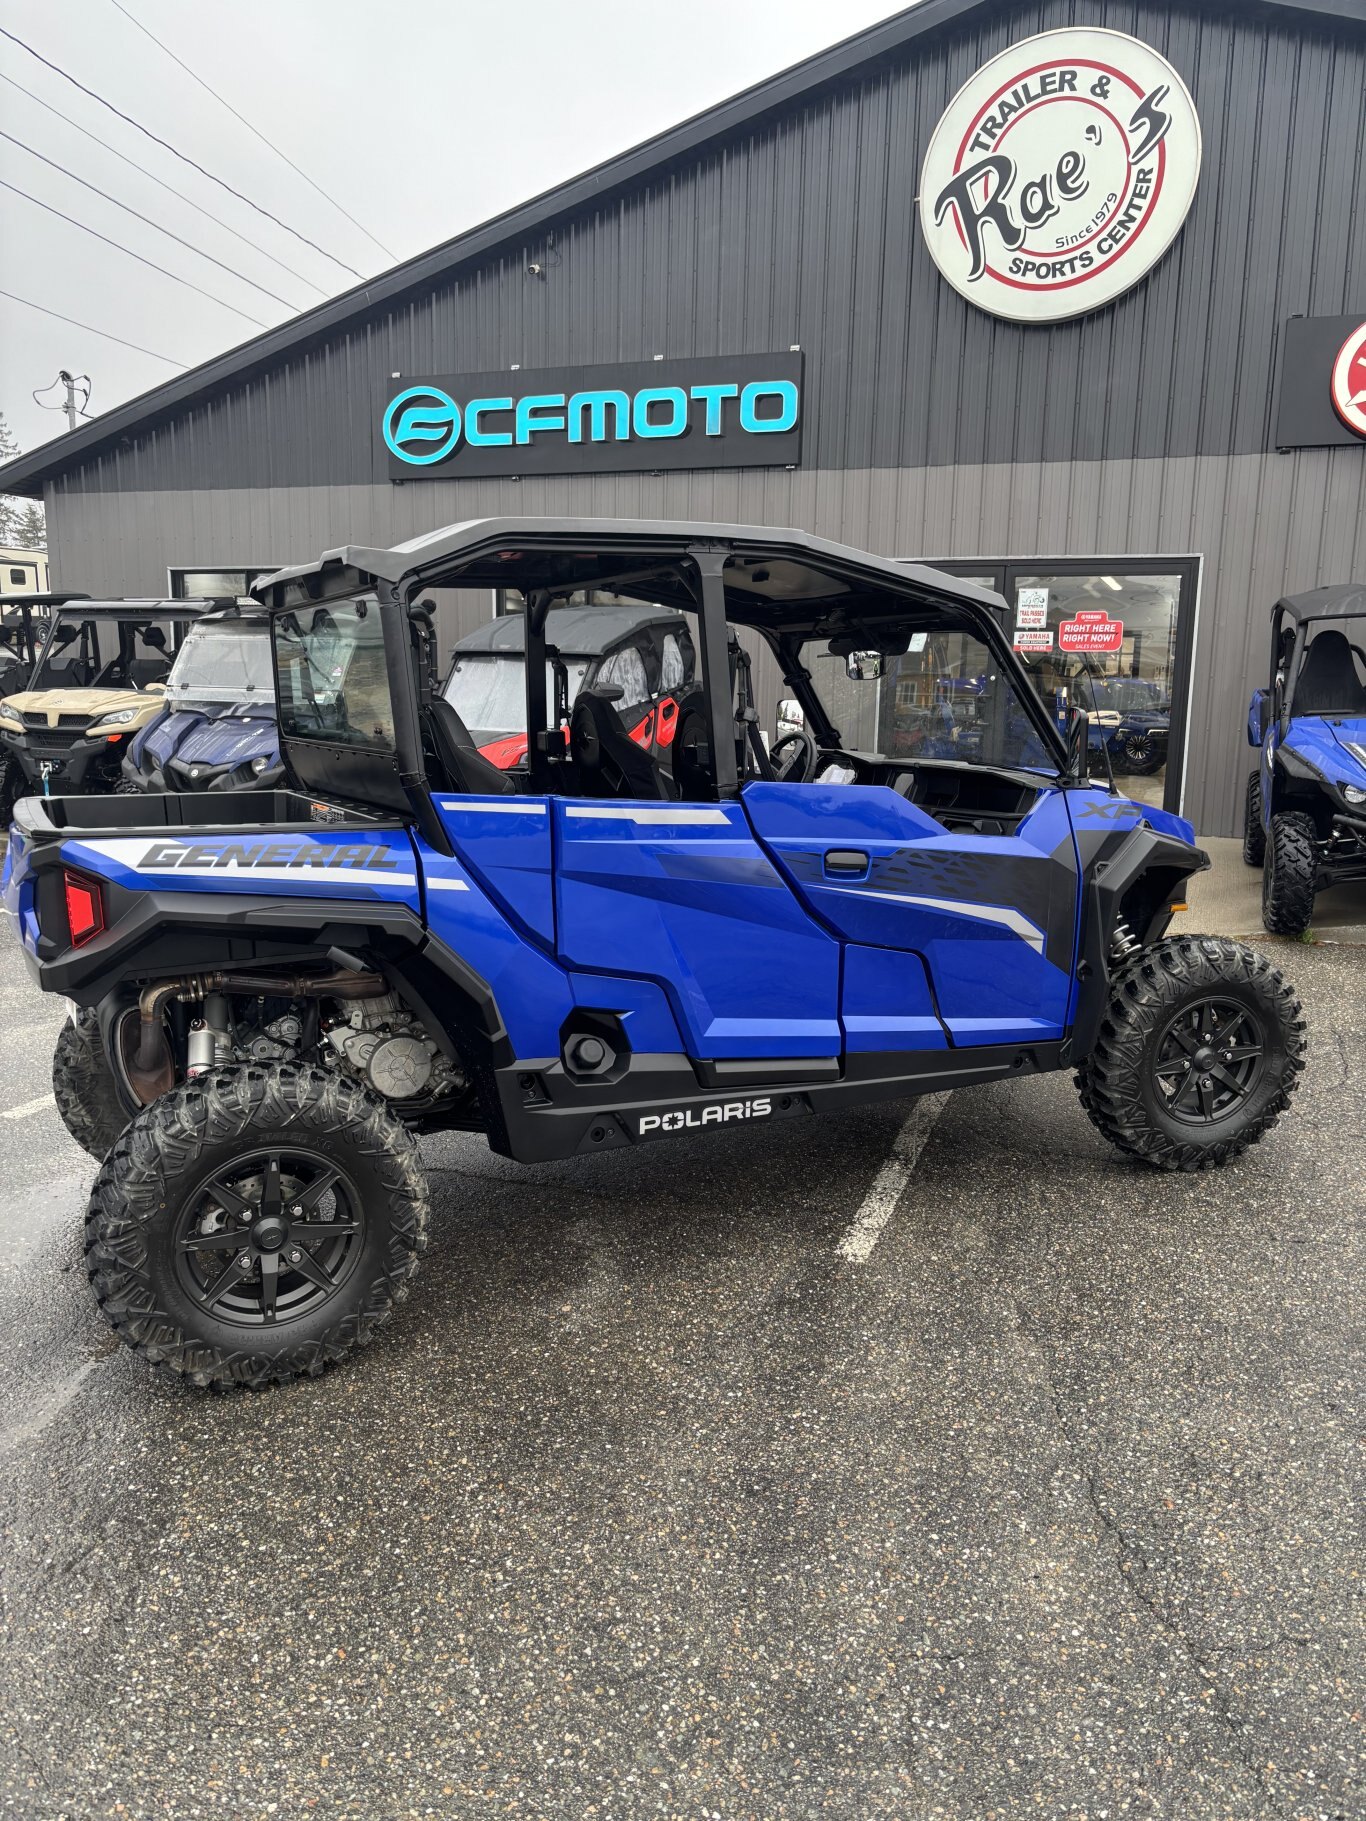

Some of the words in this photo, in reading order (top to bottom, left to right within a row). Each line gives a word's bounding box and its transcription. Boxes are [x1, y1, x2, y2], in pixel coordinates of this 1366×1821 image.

[969, 69, 1079, 155] TRAILER
[1089, 74, 1112, 100] &
[1008, 253, 1094, 280] SPORTS
[1096, 167, 1154, 256] CENTER
[1054, 224, 1094, 249] Since
[1092, 192, 1118, 228] 1979
[464, 379, 799, 447] CFMOTO
[1063, 634, 1090, 642] RIGHT
[1090, 634, 1115, 642] NOW!
[1064, 624, 1091, 632] RIGHT
[1092, 624, 1116, 632] HERE
[1075, 801, 1143, 819] XP
[137, 843, 399, 868] GENERAL
[639, 1097, 772, 1135] POLARIS
